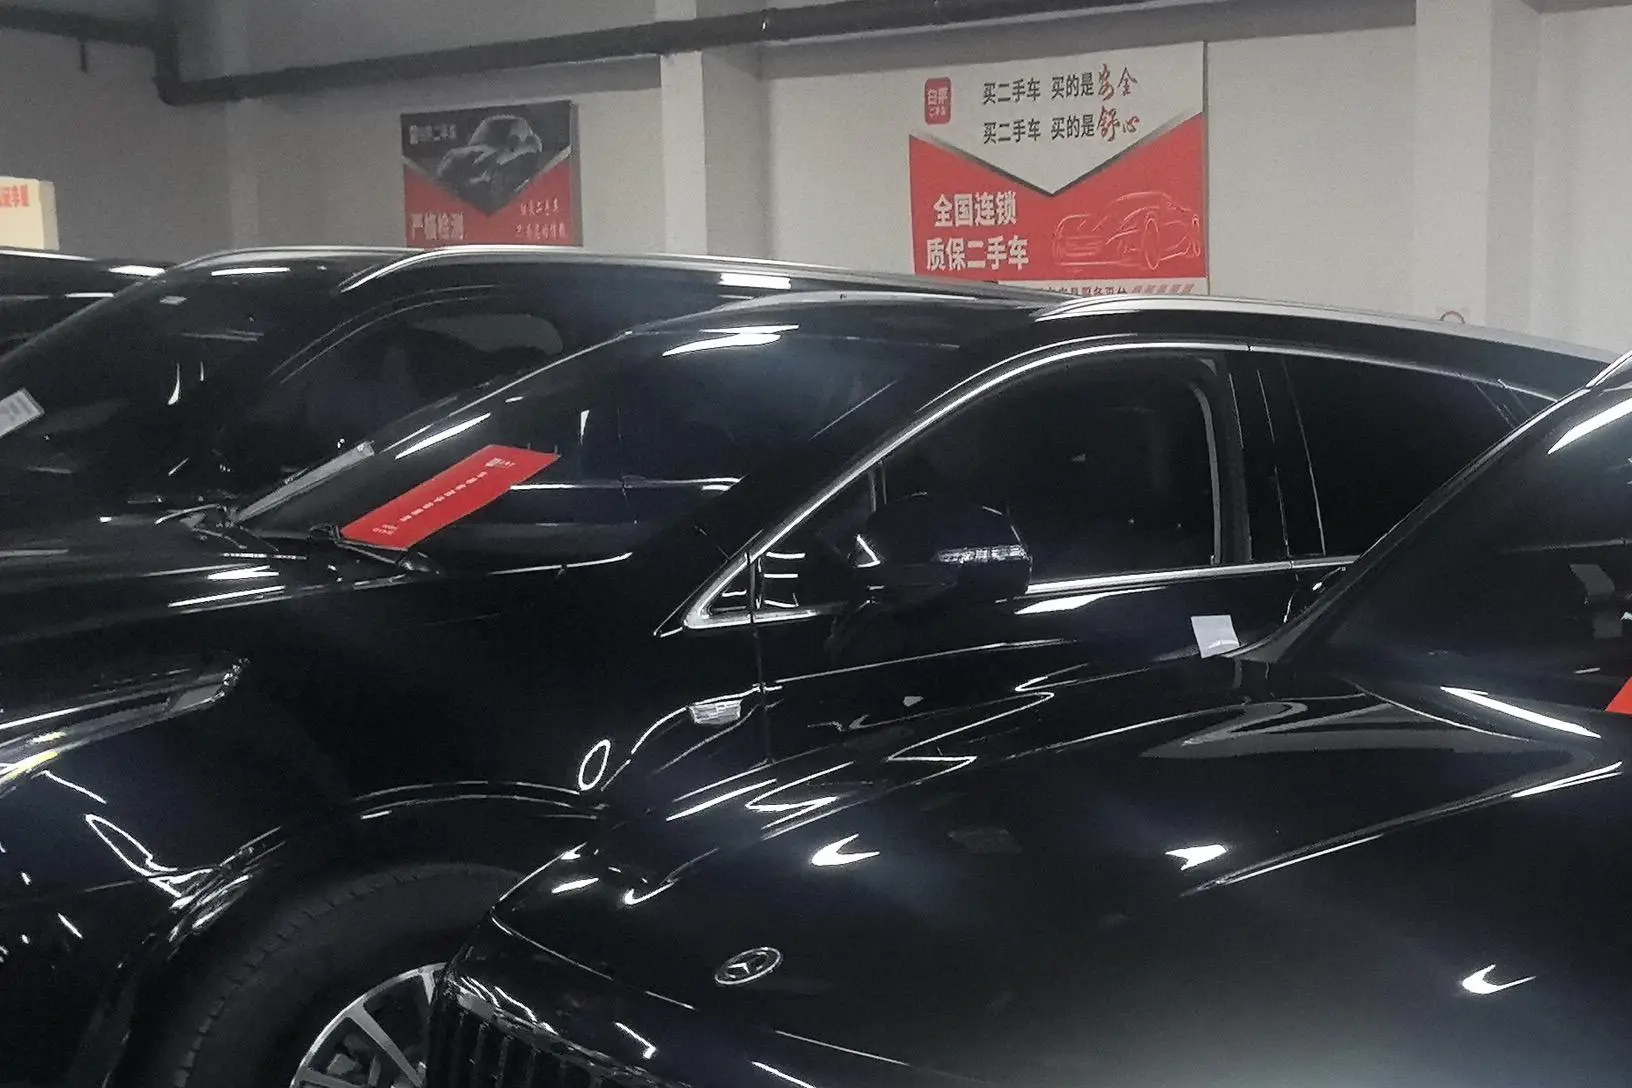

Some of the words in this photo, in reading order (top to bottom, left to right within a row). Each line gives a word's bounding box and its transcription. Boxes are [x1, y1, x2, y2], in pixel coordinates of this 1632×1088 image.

[982, 76, 1042, 106] 买二手车
[983, 117, 1042, 145] 买二手车
[933, 190, 1017, 228] 全国连锁
[926, 235, 1030, 272] 质保二手车
